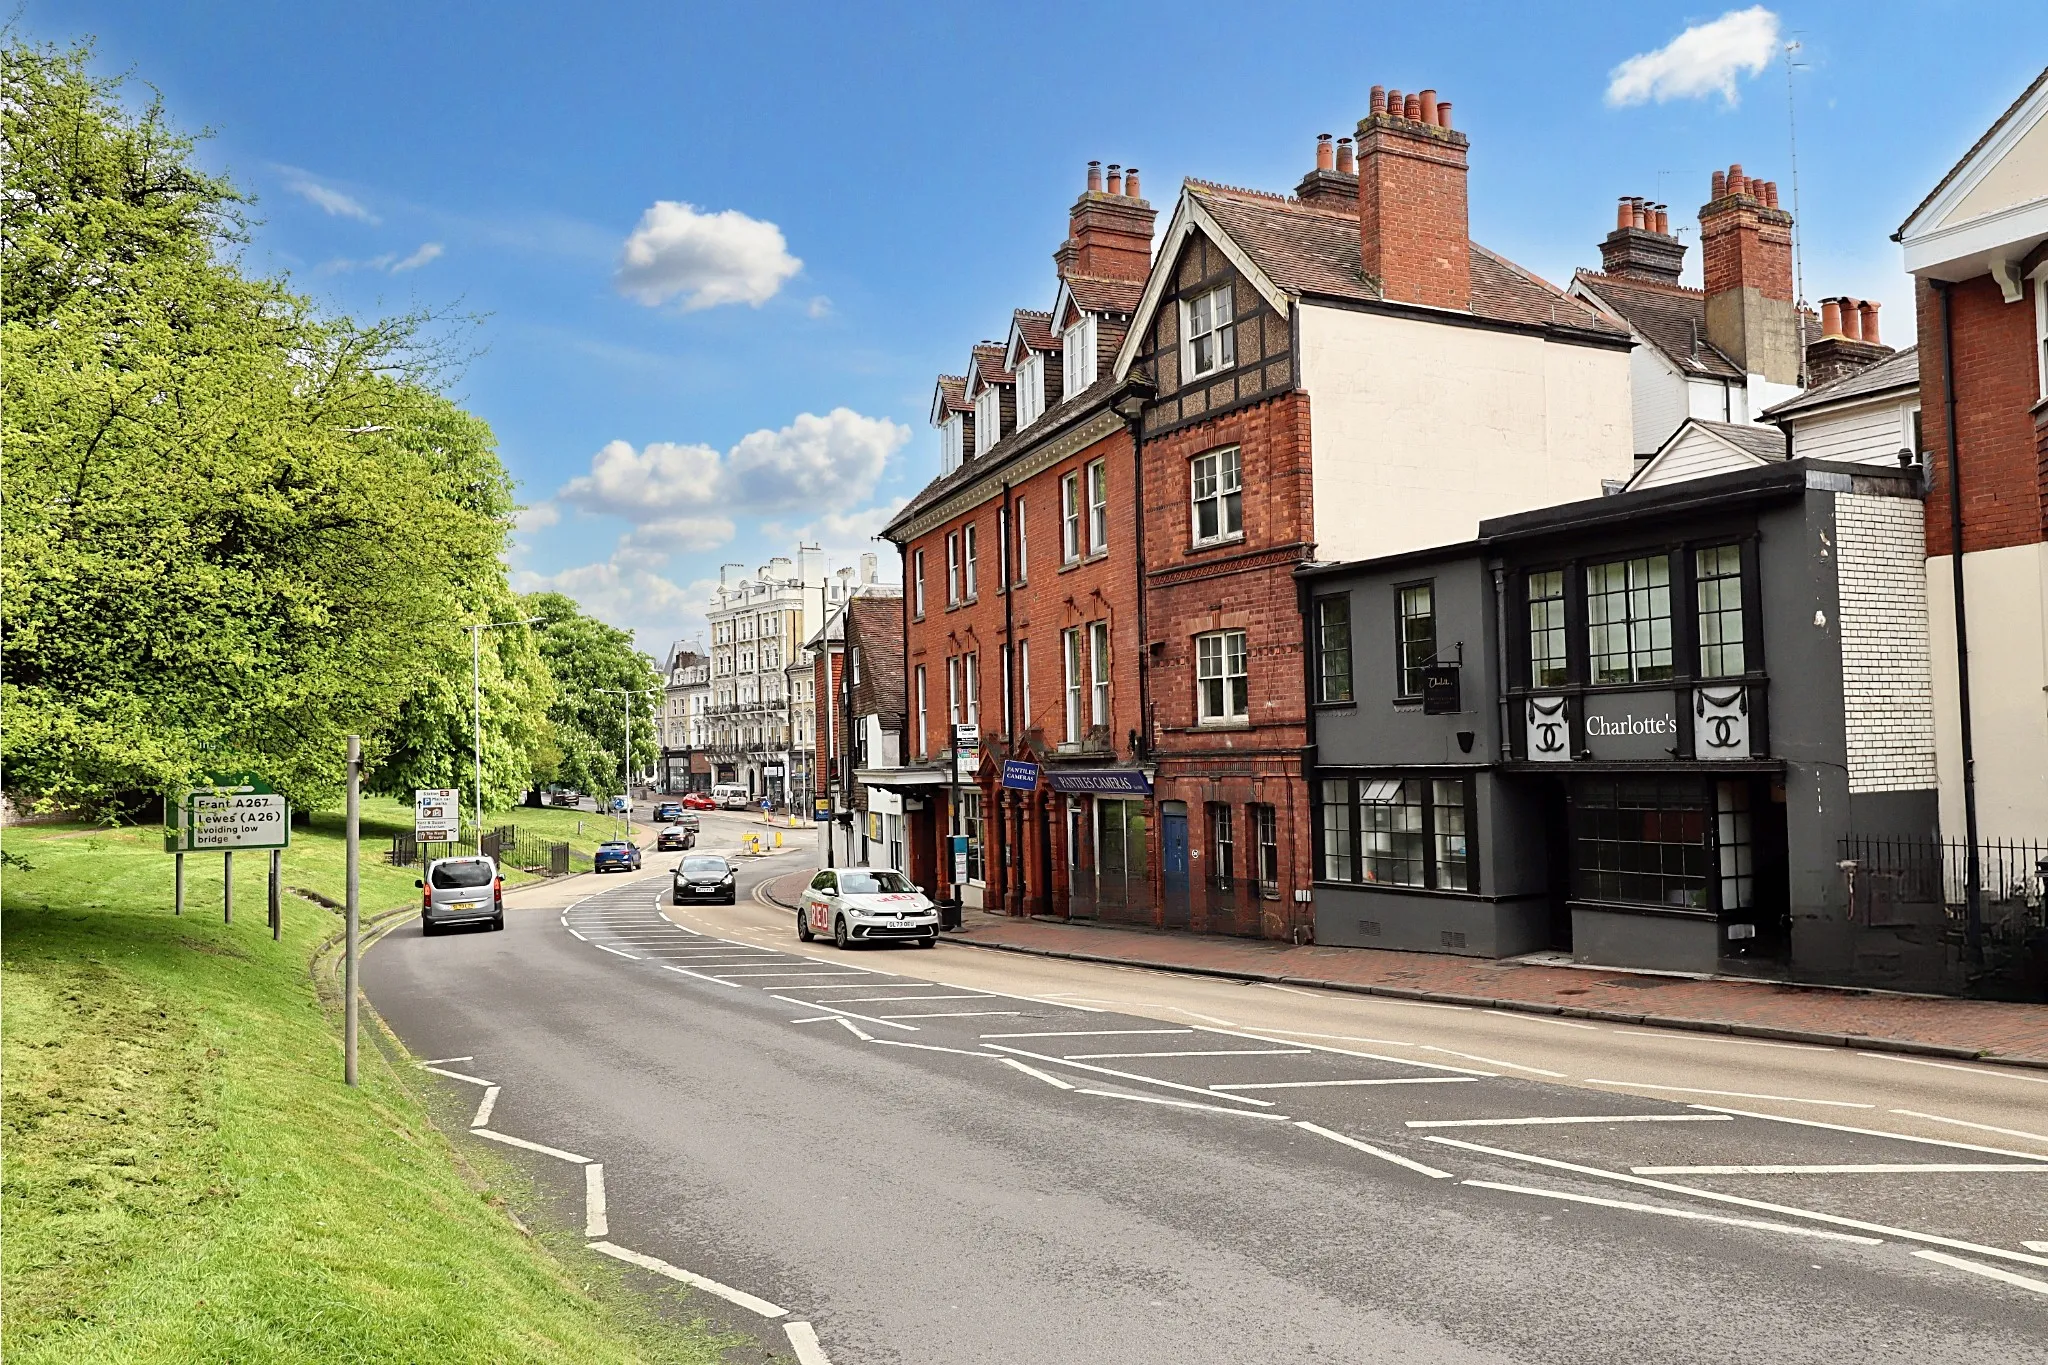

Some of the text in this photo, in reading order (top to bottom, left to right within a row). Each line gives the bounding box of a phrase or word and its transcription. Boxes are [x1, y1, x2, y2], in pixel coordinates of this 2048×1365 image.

[1586, 713, 1677, 736] Charlotte's
[1006, 766, 1036, 776] PANTILES
[1006, 773, 1034, 782] CAMERAS
[1058, 776, 1132, 790] PANTILES CAMERAS
[198, 798, 269, 809] Frant A267
[198, 811, 281, 823] Lewes (A26)
[198, 836, 229, 844] bridge
[811, 904, 828, 928] RED
